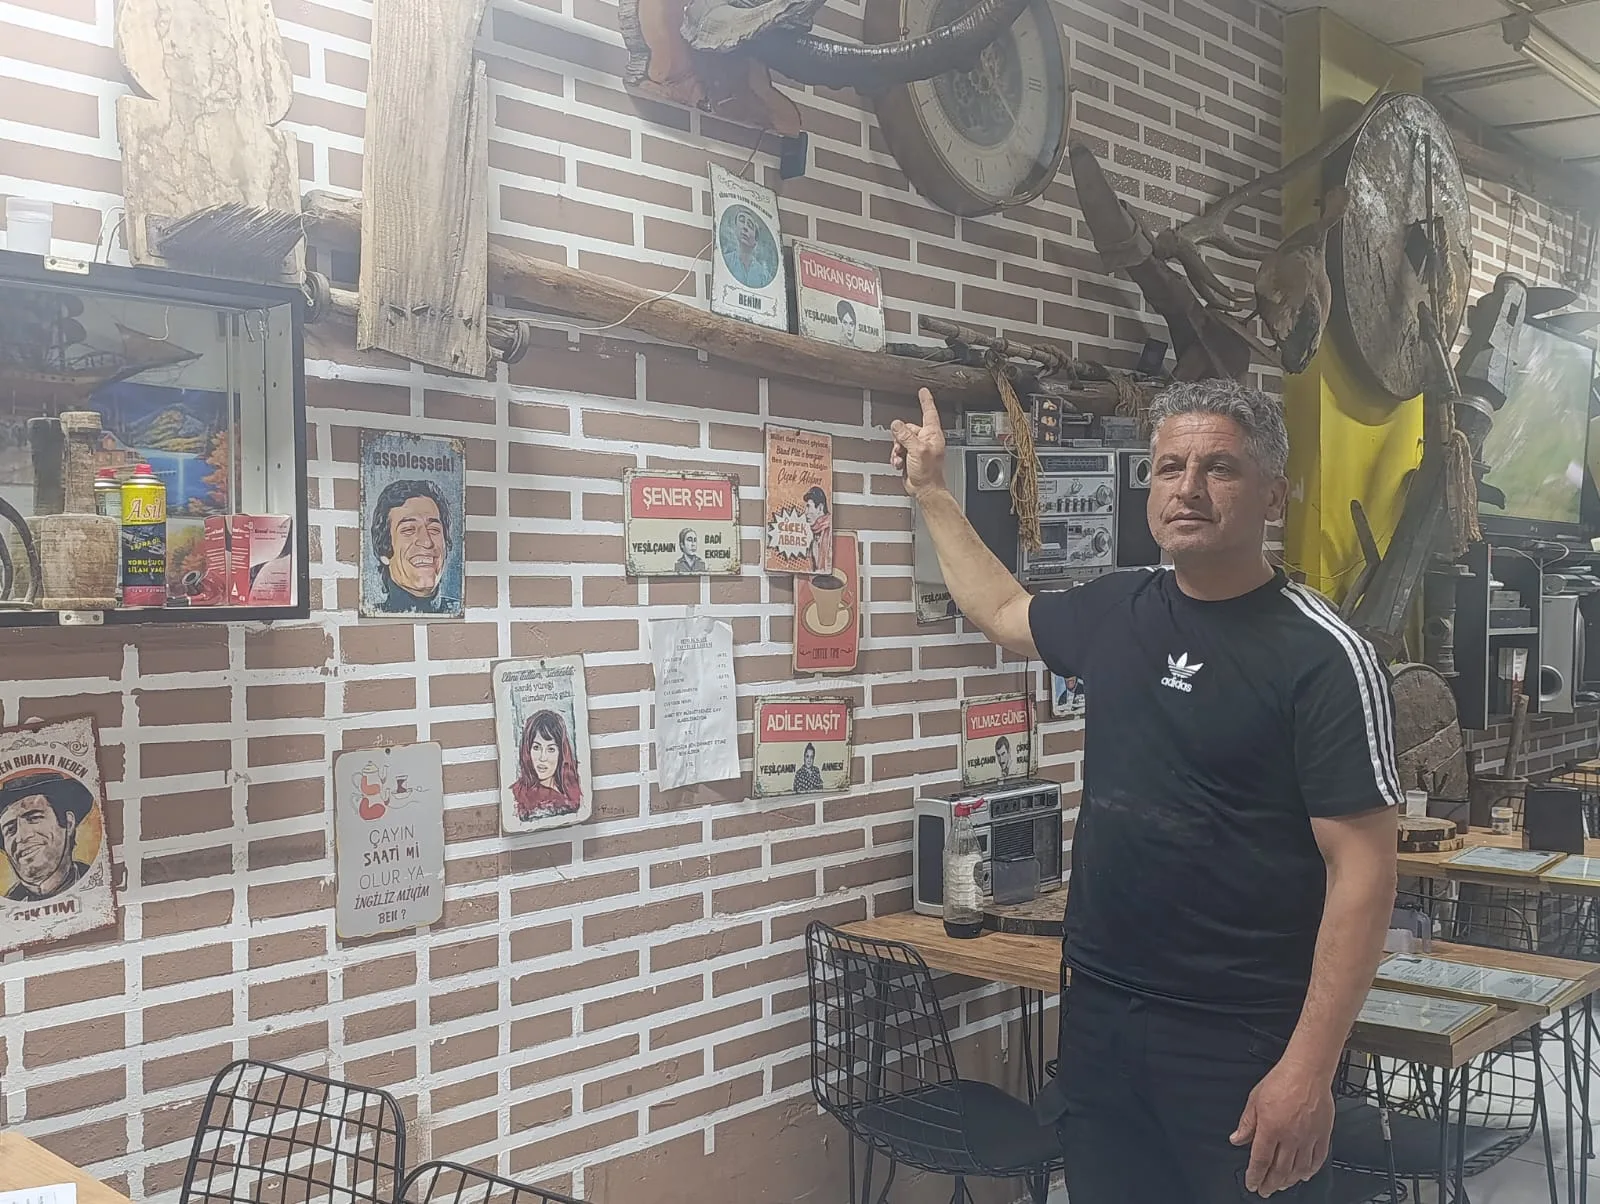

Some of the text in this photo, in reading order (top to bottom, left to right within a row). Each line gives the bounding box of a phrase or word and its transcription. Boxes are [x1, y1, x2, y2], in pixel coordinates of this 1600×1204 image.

[803, 259, 875, 295] TÜRKAN ŞORAY
[127, 498, 162, 520] Asil
[642, 486, 723, 511] ŞENER ŞEN
[704, 532, 722, 545] BADİ
[778, 535, 807, 546] ABBAS
[1161, 676, 1193, 692] adidas
[767, 709, 841, 735] ADİLE NAŞİT
[970, 713, 1001, 730] YILMAZ
[0, 753, 89, 779] EN BURAYA NEDEN
[369, 824, 415, 848] ÇAYIN
[364, 842, 420, 867] SAATİ Mİ
[359, 866, 425, 890] OLUR YA
[354, 885, 430, 910] İNGİLİZ MİYİM
[378, 911, 397, 924] BEN
